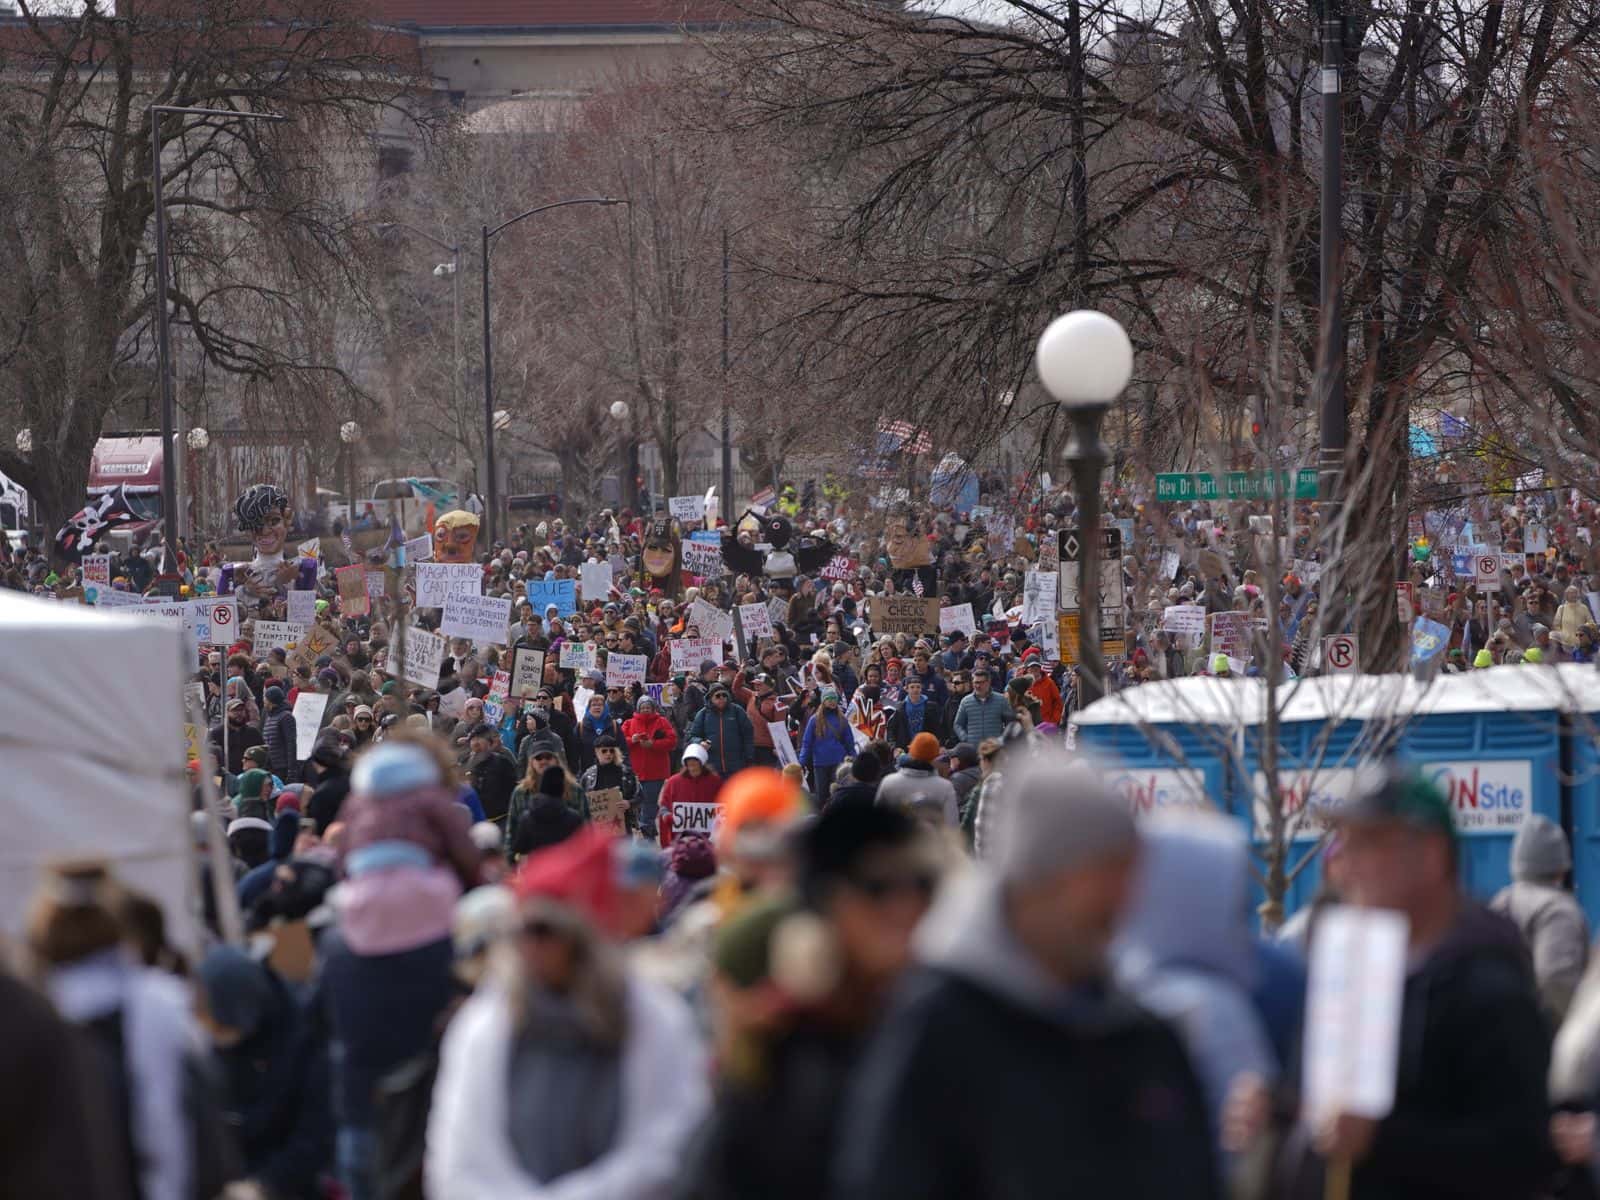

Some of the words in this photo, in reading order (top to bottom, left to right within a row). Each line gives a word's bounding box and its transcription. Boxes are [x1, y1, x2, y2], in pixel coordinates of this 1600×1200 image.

[1159, 480, 1176, 495] Rev
[1180, 479, 1191, 494] Dr
[831, 556, 849, 568] NO
[417, 566, 448, 579] MAGA
[820, 566, 855, 580] KINGS
[452, 581, 476, 593] GET
[530, 581, 572, 596] DUE
[161, 606, 186, 617] WON'T
[888, 606, 925, 616] CHECKS
[882, 623, 924, 633] BALANCES
[672, 641, 685, 649] WE
[690, 639, 700, 648] THE
